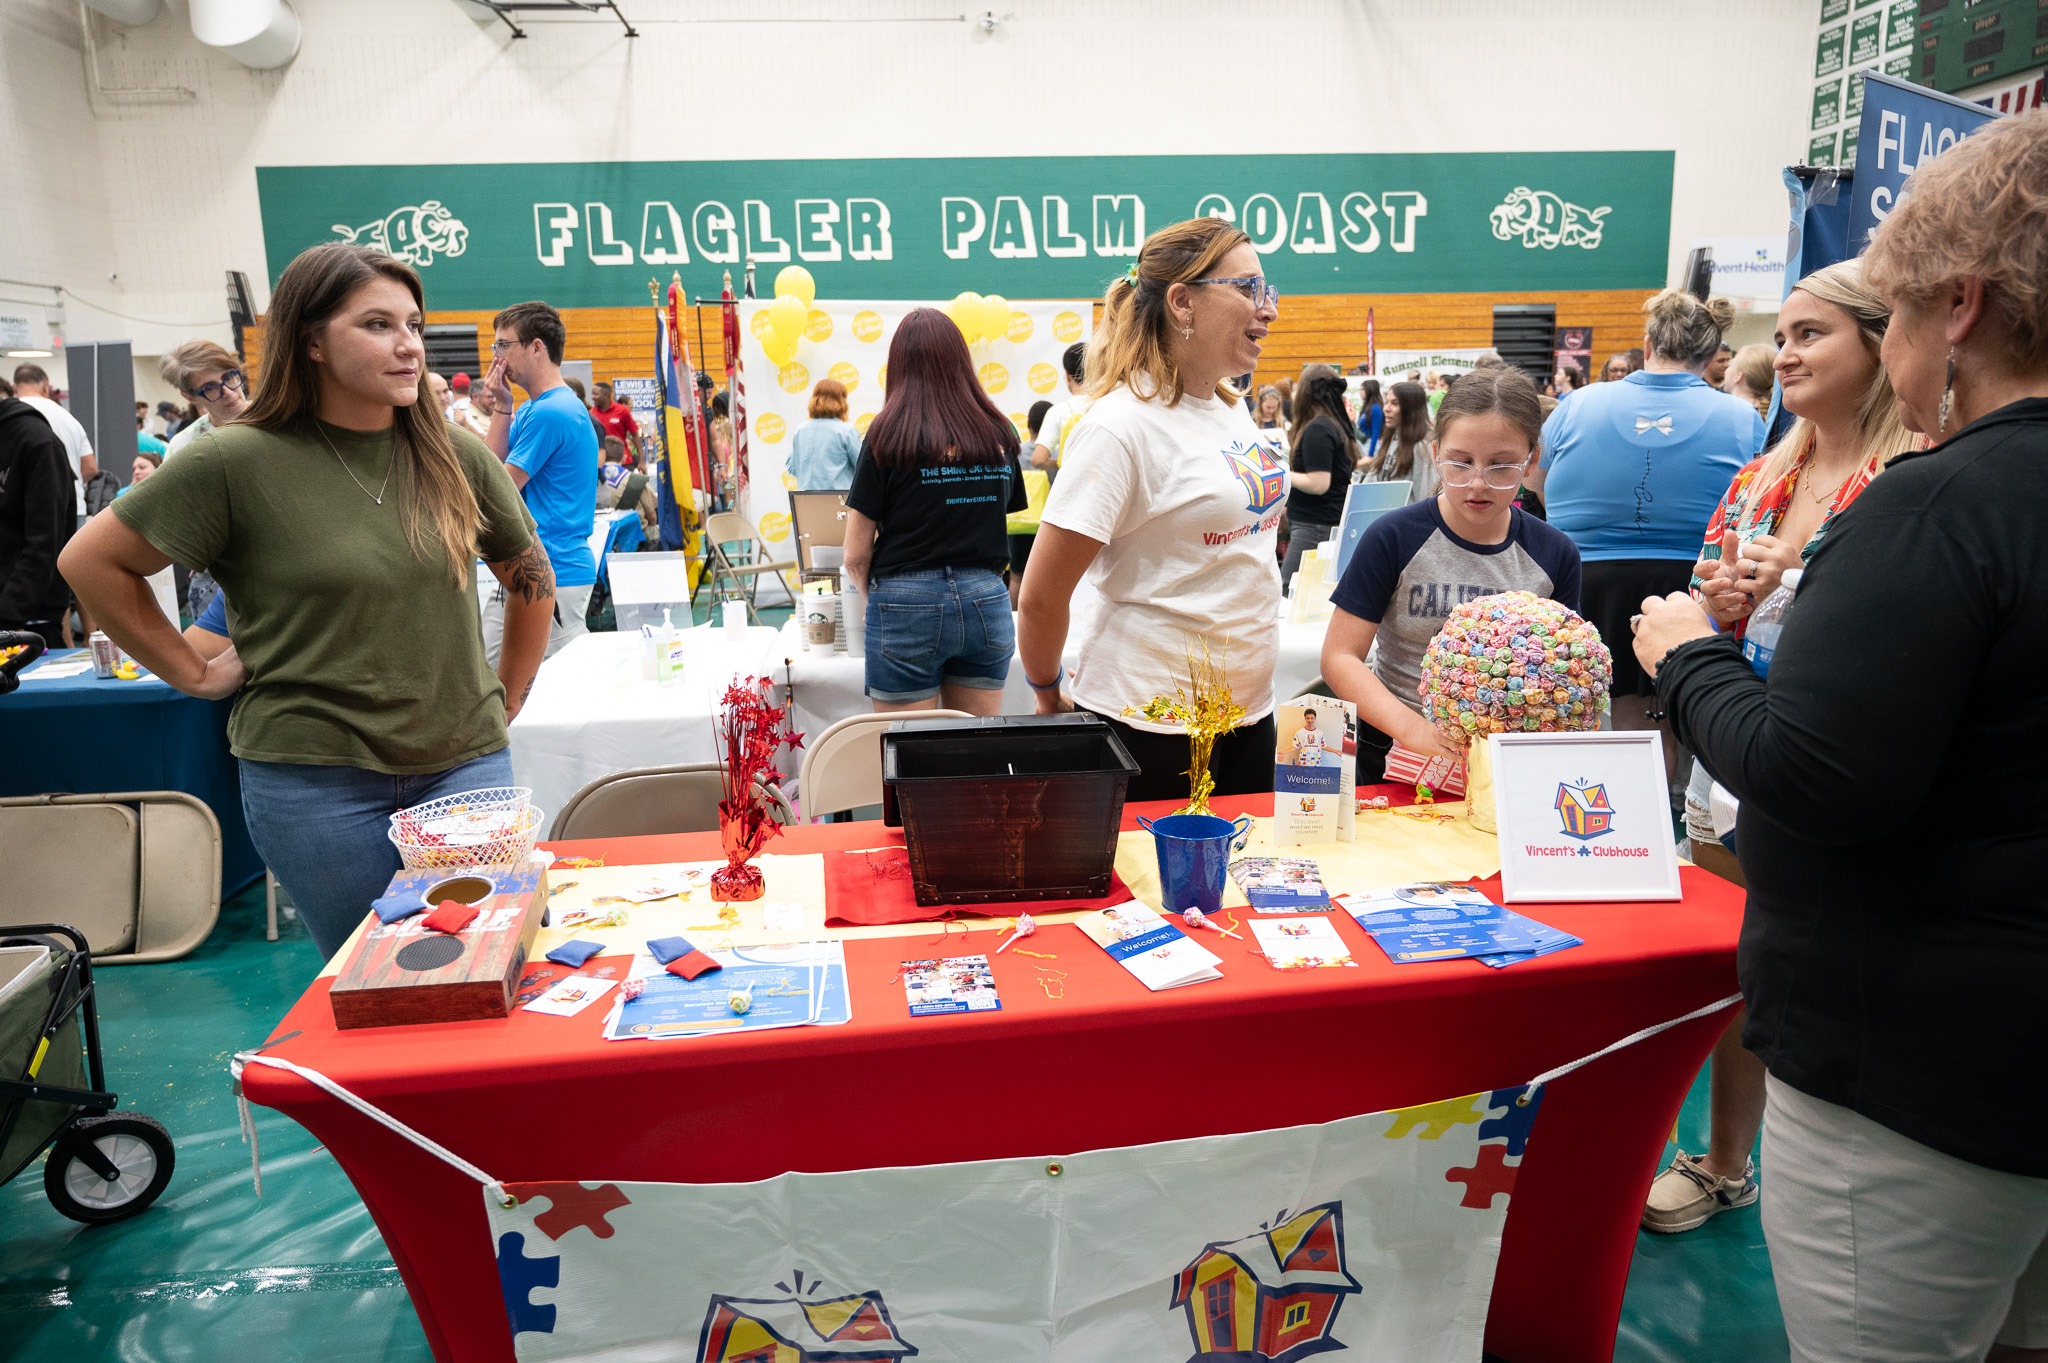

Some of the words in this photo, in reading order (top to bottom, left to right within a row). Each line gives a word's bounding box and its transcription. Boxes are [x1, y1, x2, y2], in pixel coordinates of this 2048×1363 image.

[534, 198, 893, 266] FLAGLER
[942, 194, 1146, 259] PALM
[1703, 261, 1785, 274] dventHealth
[615, 380, 644, 389] LEWIS
[920, 467, 939, 477] THE
[1287, 774, 1331, 785] Welcome!
[1525, 845, 1576, 857] Vincent's
[1592, 845, 1649, 857] Clubhouse
[1121, 931, 1171, 953] Welcome!
